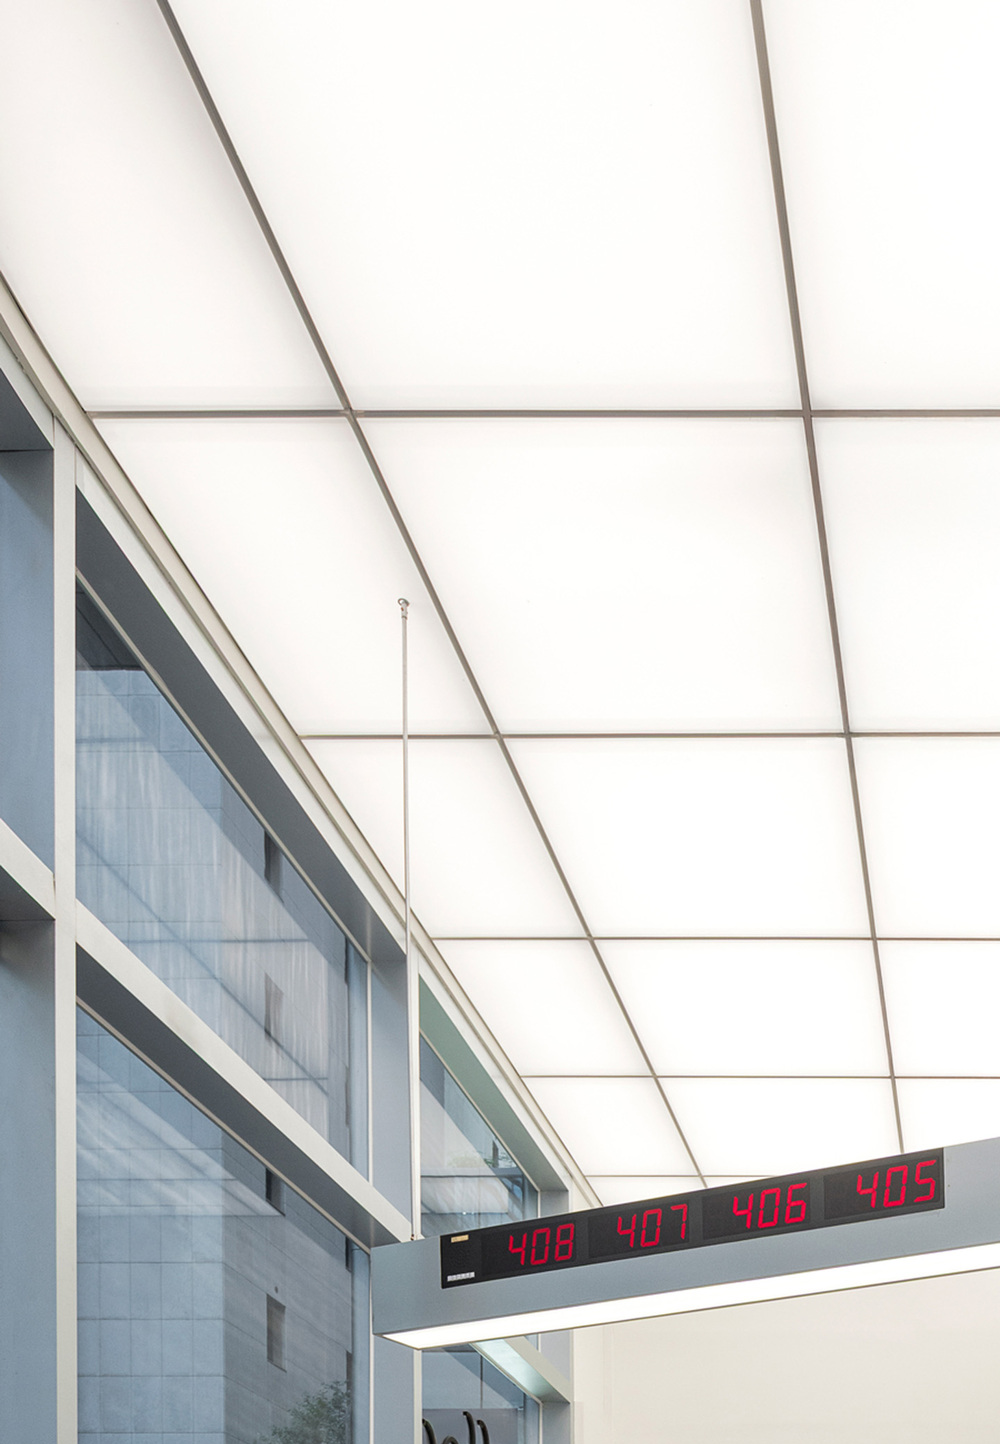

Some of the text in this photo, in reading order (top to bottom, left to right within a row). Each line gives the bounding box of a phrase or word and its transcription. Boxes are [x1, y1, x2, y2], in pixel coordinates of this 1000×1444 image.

[508, 1160, 937, 1266] 408 407 406 405
